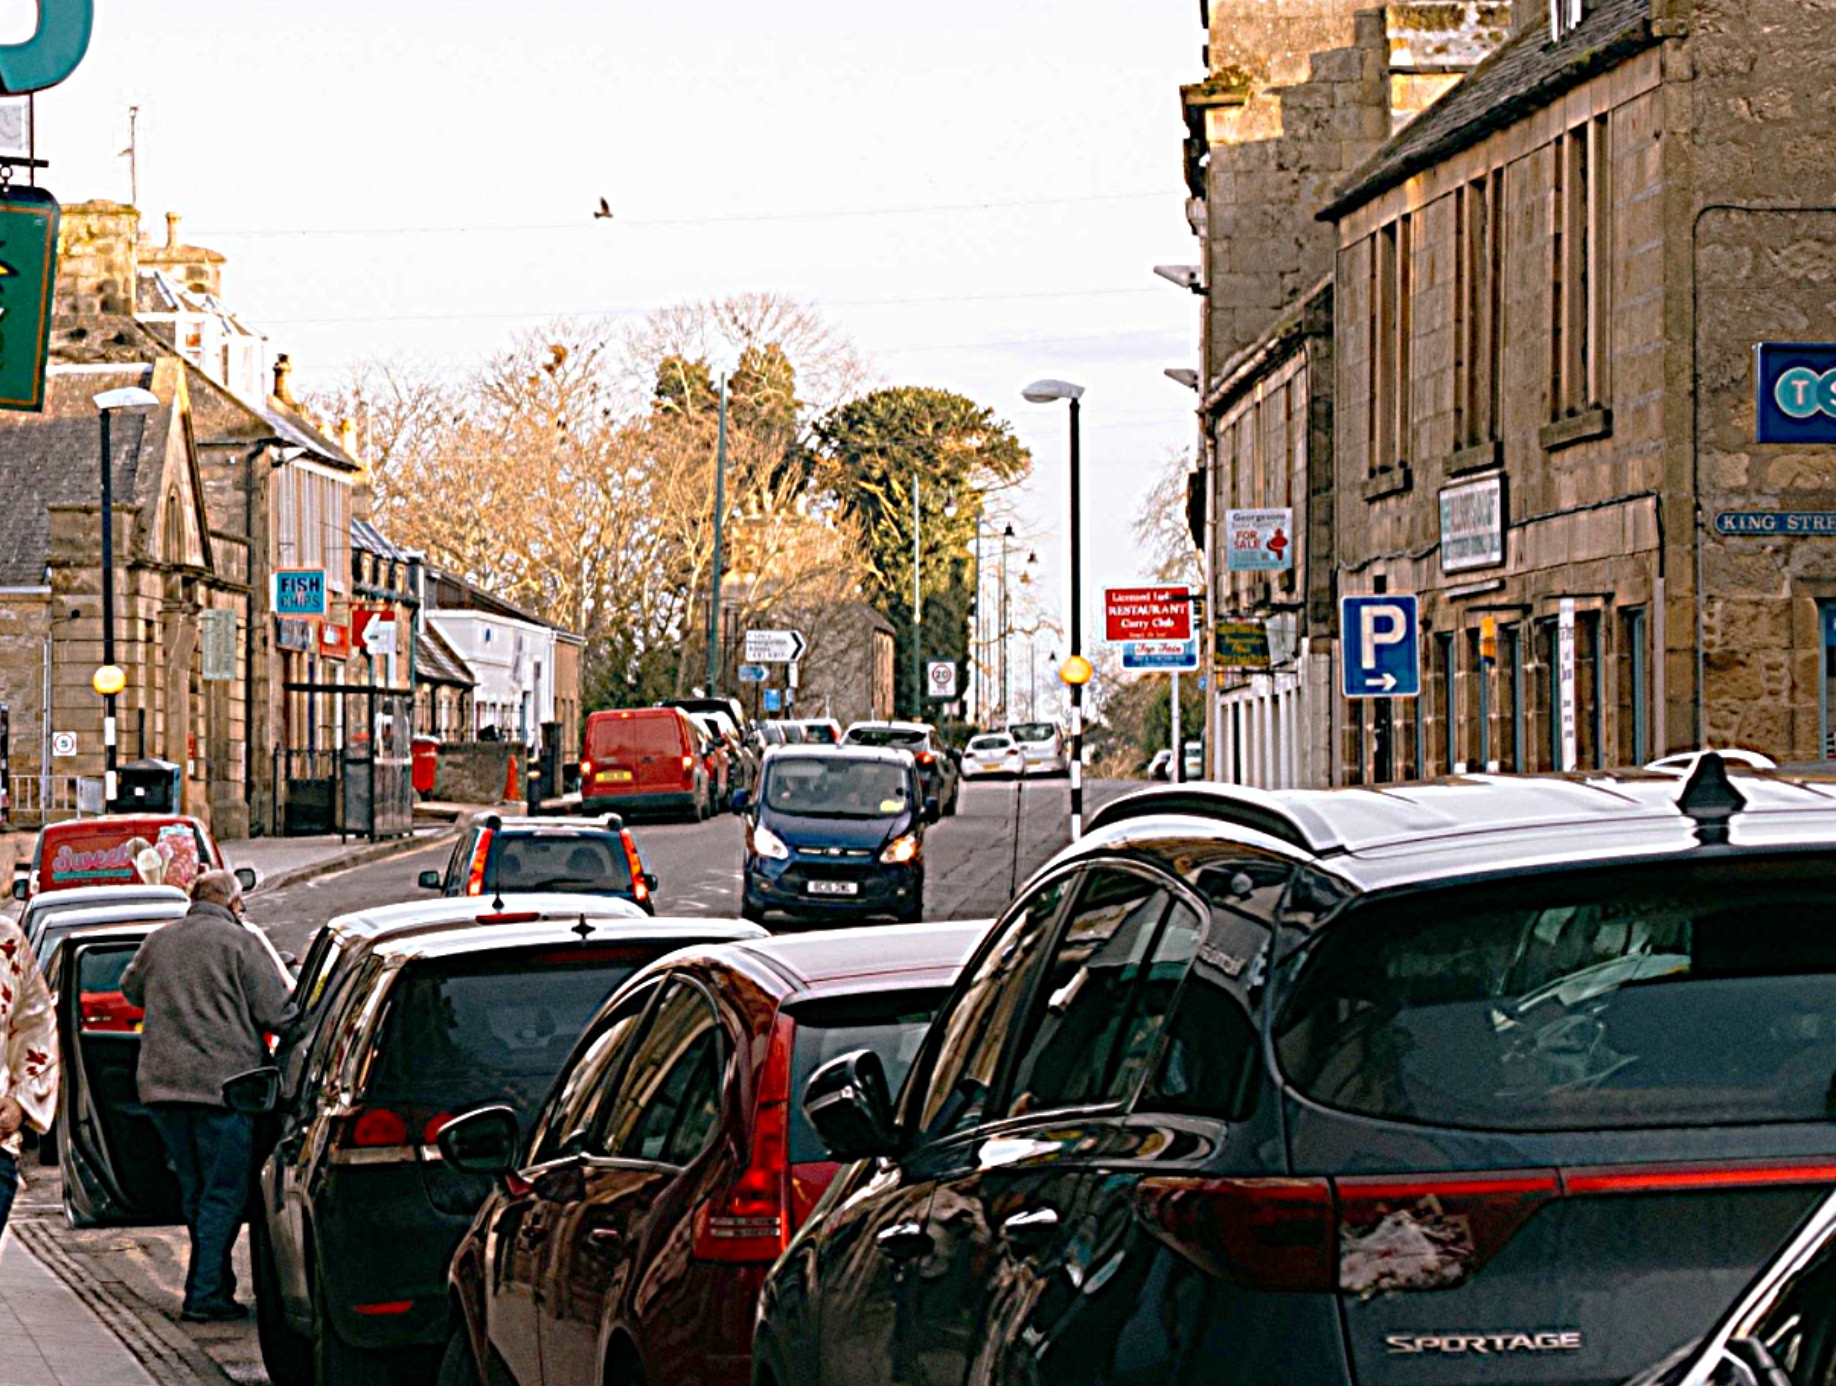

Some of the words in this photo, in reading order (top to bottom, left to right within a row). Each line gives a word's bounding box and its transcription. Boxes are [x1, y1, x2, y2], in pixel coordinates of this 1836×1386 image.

[1723, 515, 1776, 531] KING
[1787, 515, 1836, 531] STRE
[1236, 531, 1258, 539] FOR
[1233, 539, 1261, 549] SALE
[281, 577, 320, 592] FISH
[281, 595, 321, 608] CHIPS
[1107, 603, 1188, 616] RESTAURANT
[1120, 618, 1150, 631] Curry
[1151, 617, 1175, 628] Club
[1360, 606, 1408, 669] P
[1387, 1331, 1582, 1355] SPORTAGE
